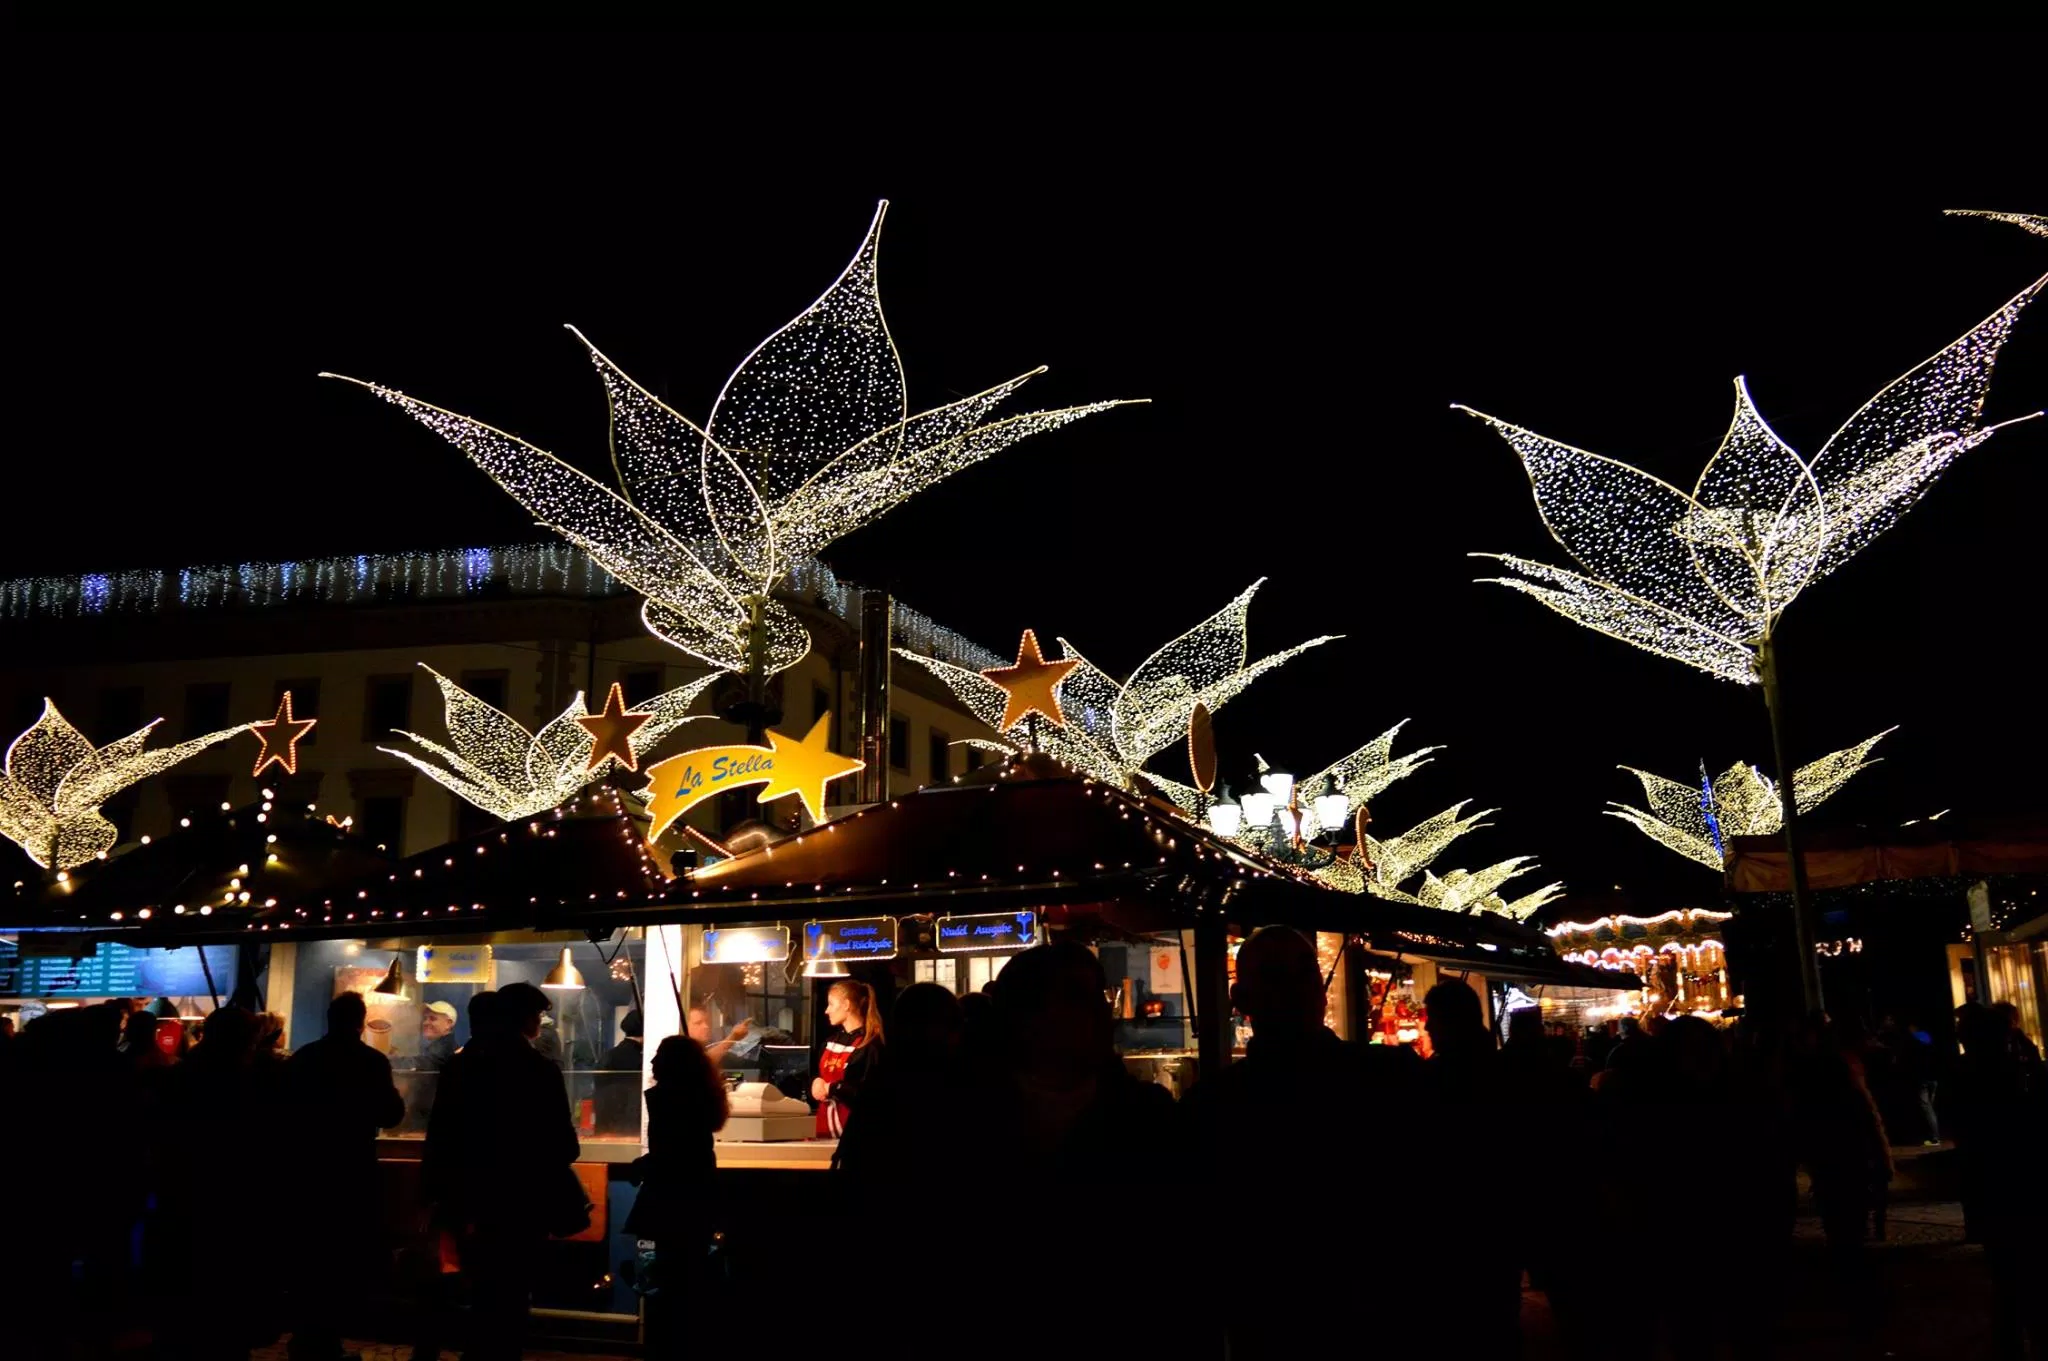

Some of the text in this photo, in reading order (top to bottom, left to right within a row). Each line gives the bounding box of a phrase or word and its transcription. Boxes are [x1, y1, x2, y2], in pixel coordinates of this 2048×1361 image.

[675, 754, 774, 799] La Stella
[941, 922, 1013, 938] Nudel Ausgabe
